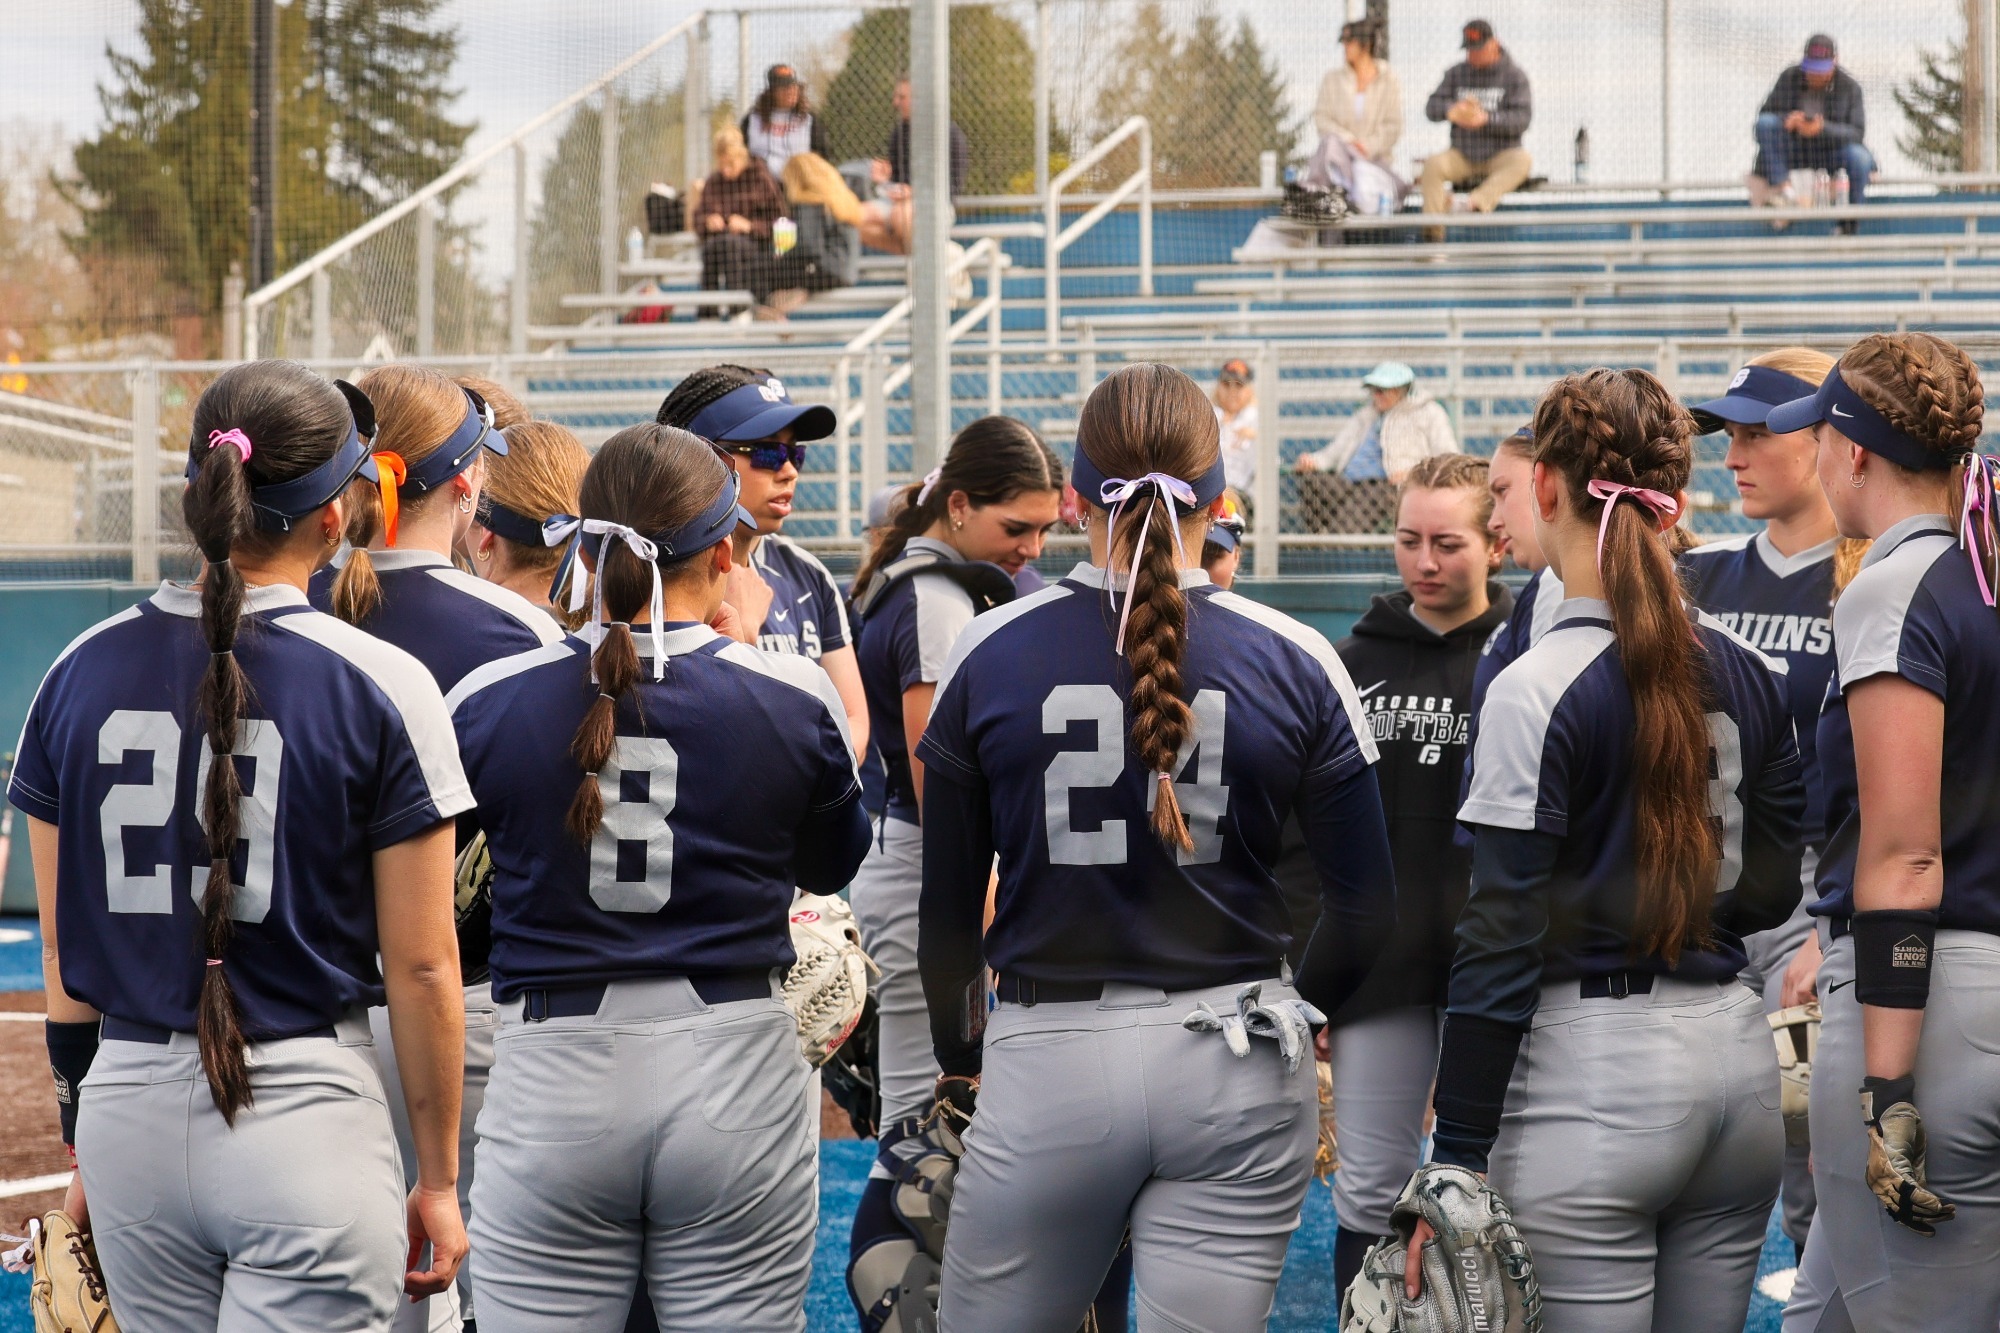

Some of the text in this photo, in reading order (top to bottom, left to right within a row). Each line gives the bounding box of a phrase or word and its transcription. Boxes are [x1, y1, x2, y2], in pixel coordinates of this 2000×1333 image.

[1363, 695, 1453, 713] GEORGE
[98, 709, 284, 924] 29
[588, 735, 679, 914] 8
[1042, 684, 1230, 866] 24
[1894, 953, 1926, 961] ZONE
[1455, 1251, 1490, 1333] marucci
